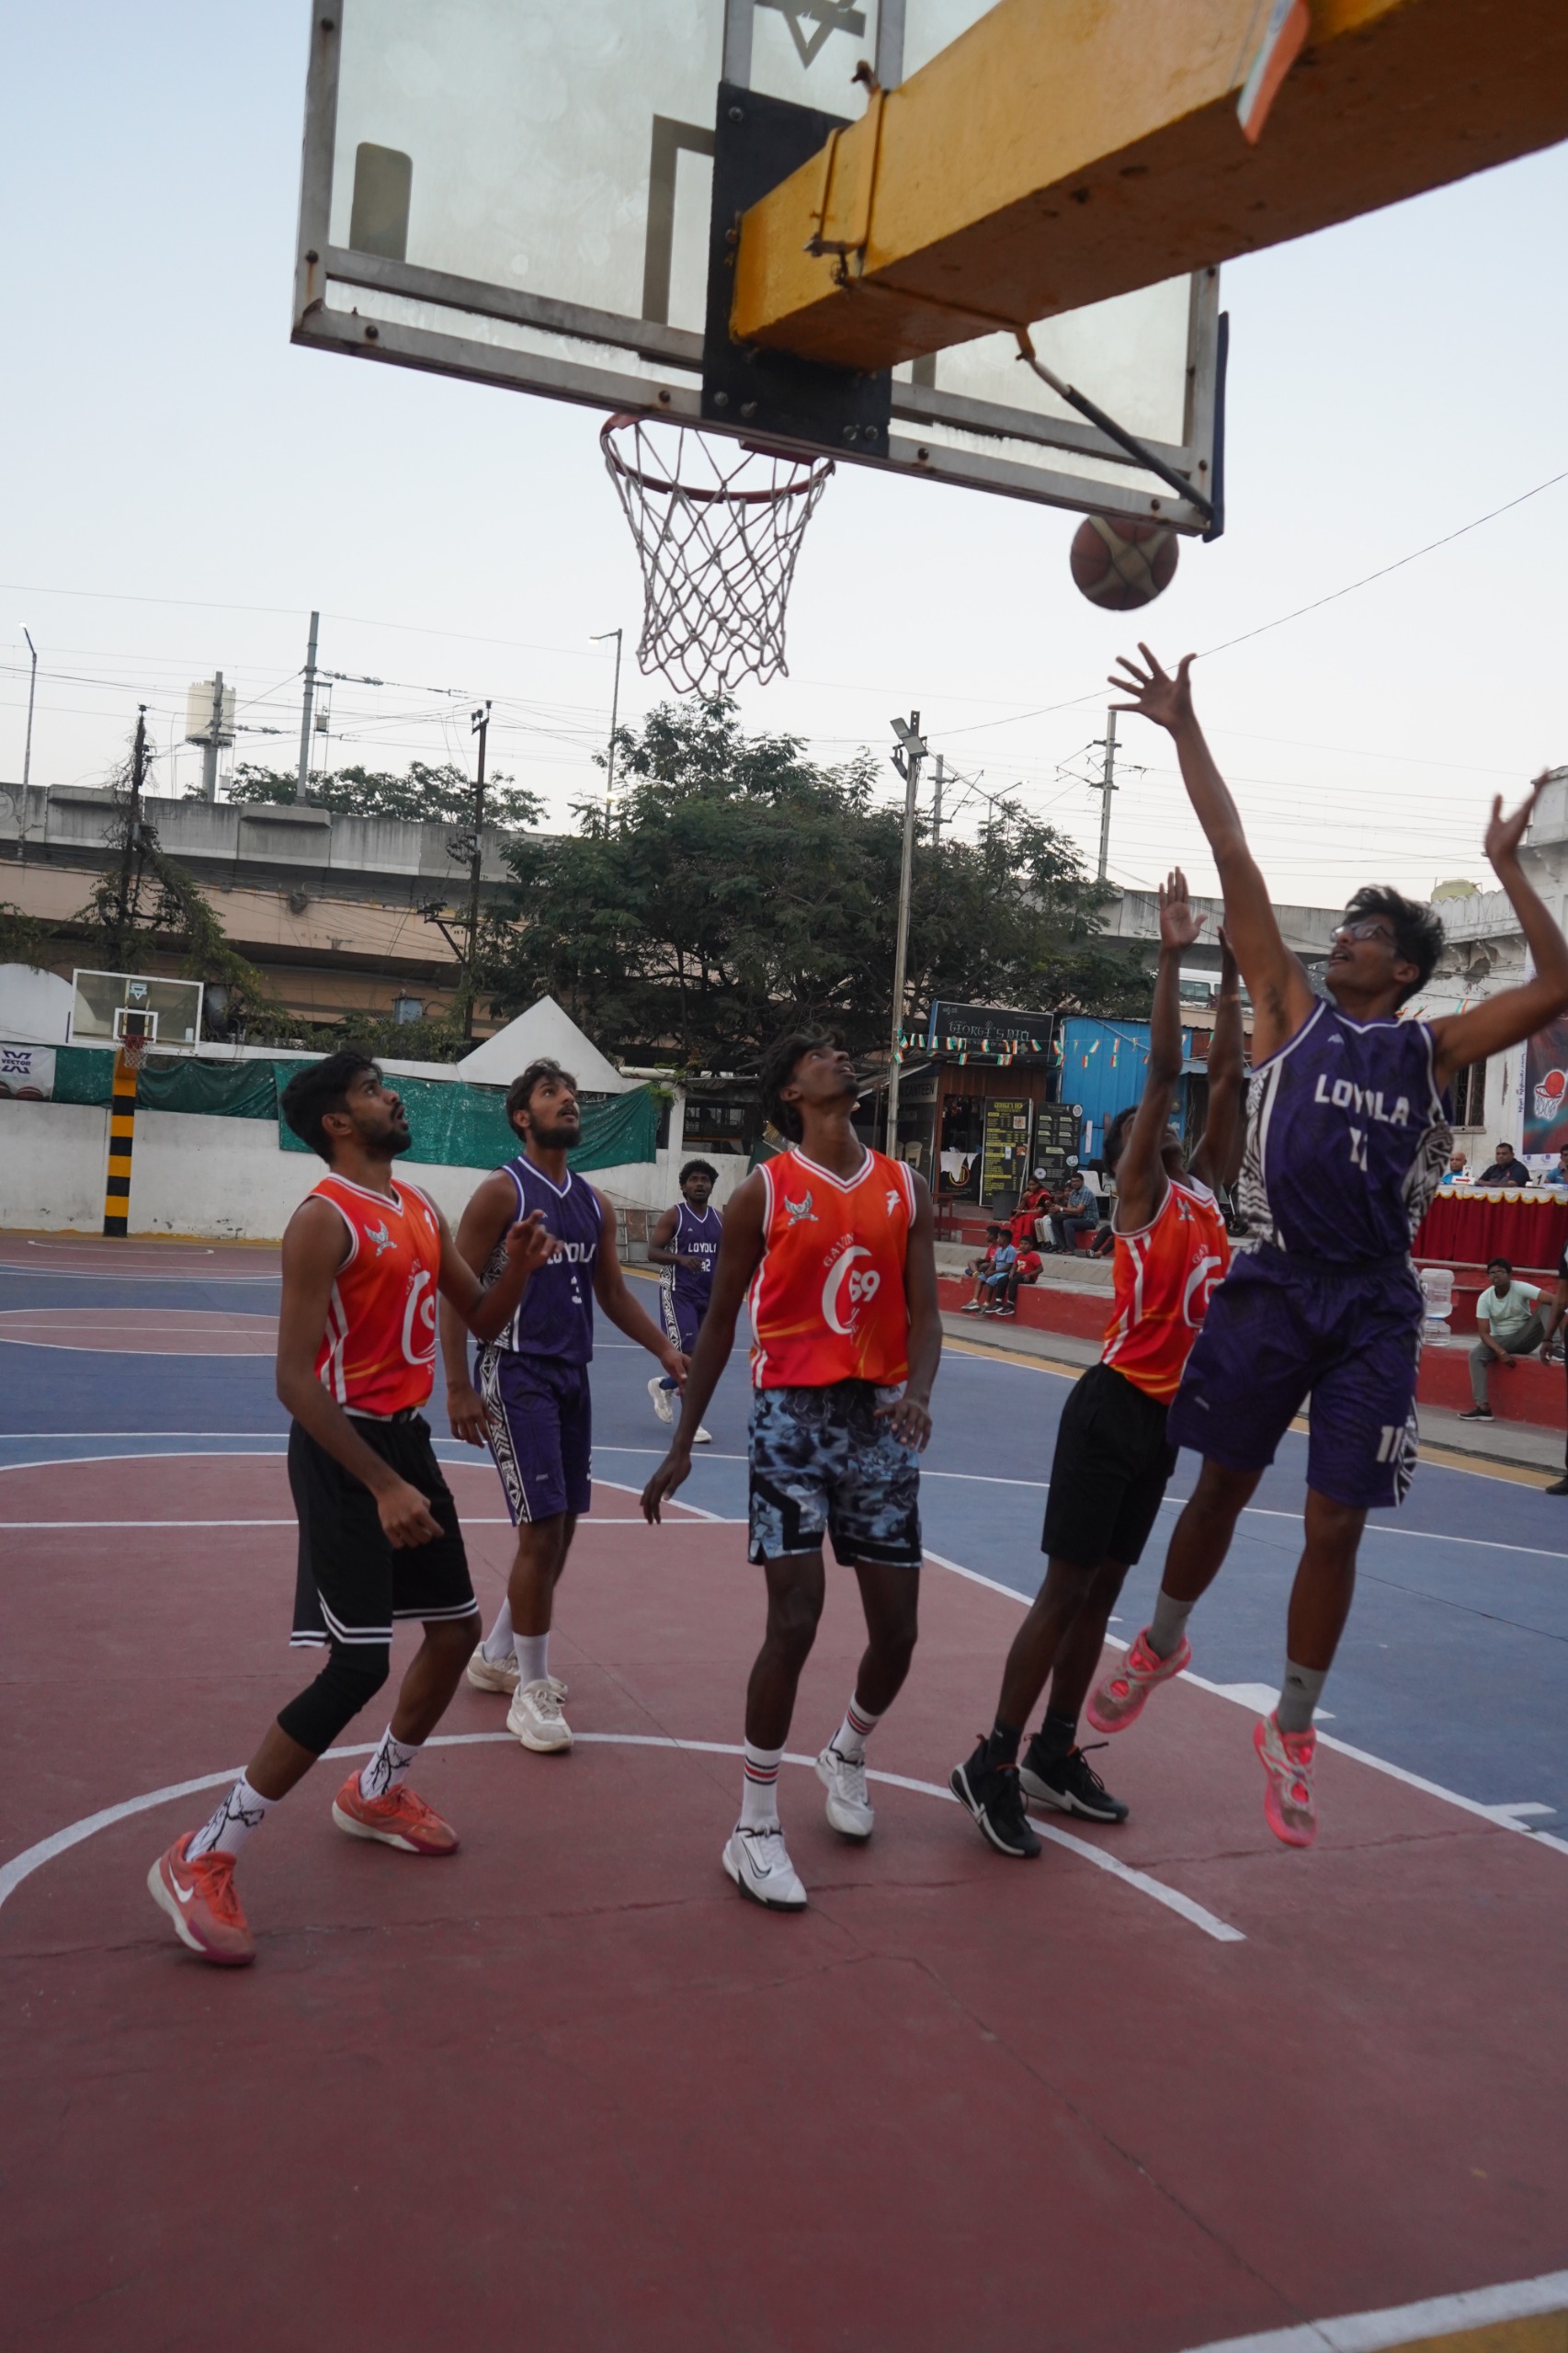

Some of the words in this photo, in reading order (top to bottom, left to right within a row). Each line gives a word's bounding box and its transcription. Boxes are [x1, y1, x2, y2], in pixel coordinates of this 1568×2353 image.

[2, 1058, 31, 1066] VECTOR
[824, 1232, 854, 1267] GAVIN
[848, 1269, 881, 1302] 69
[1376, 1426, 1404, 1463] 11
